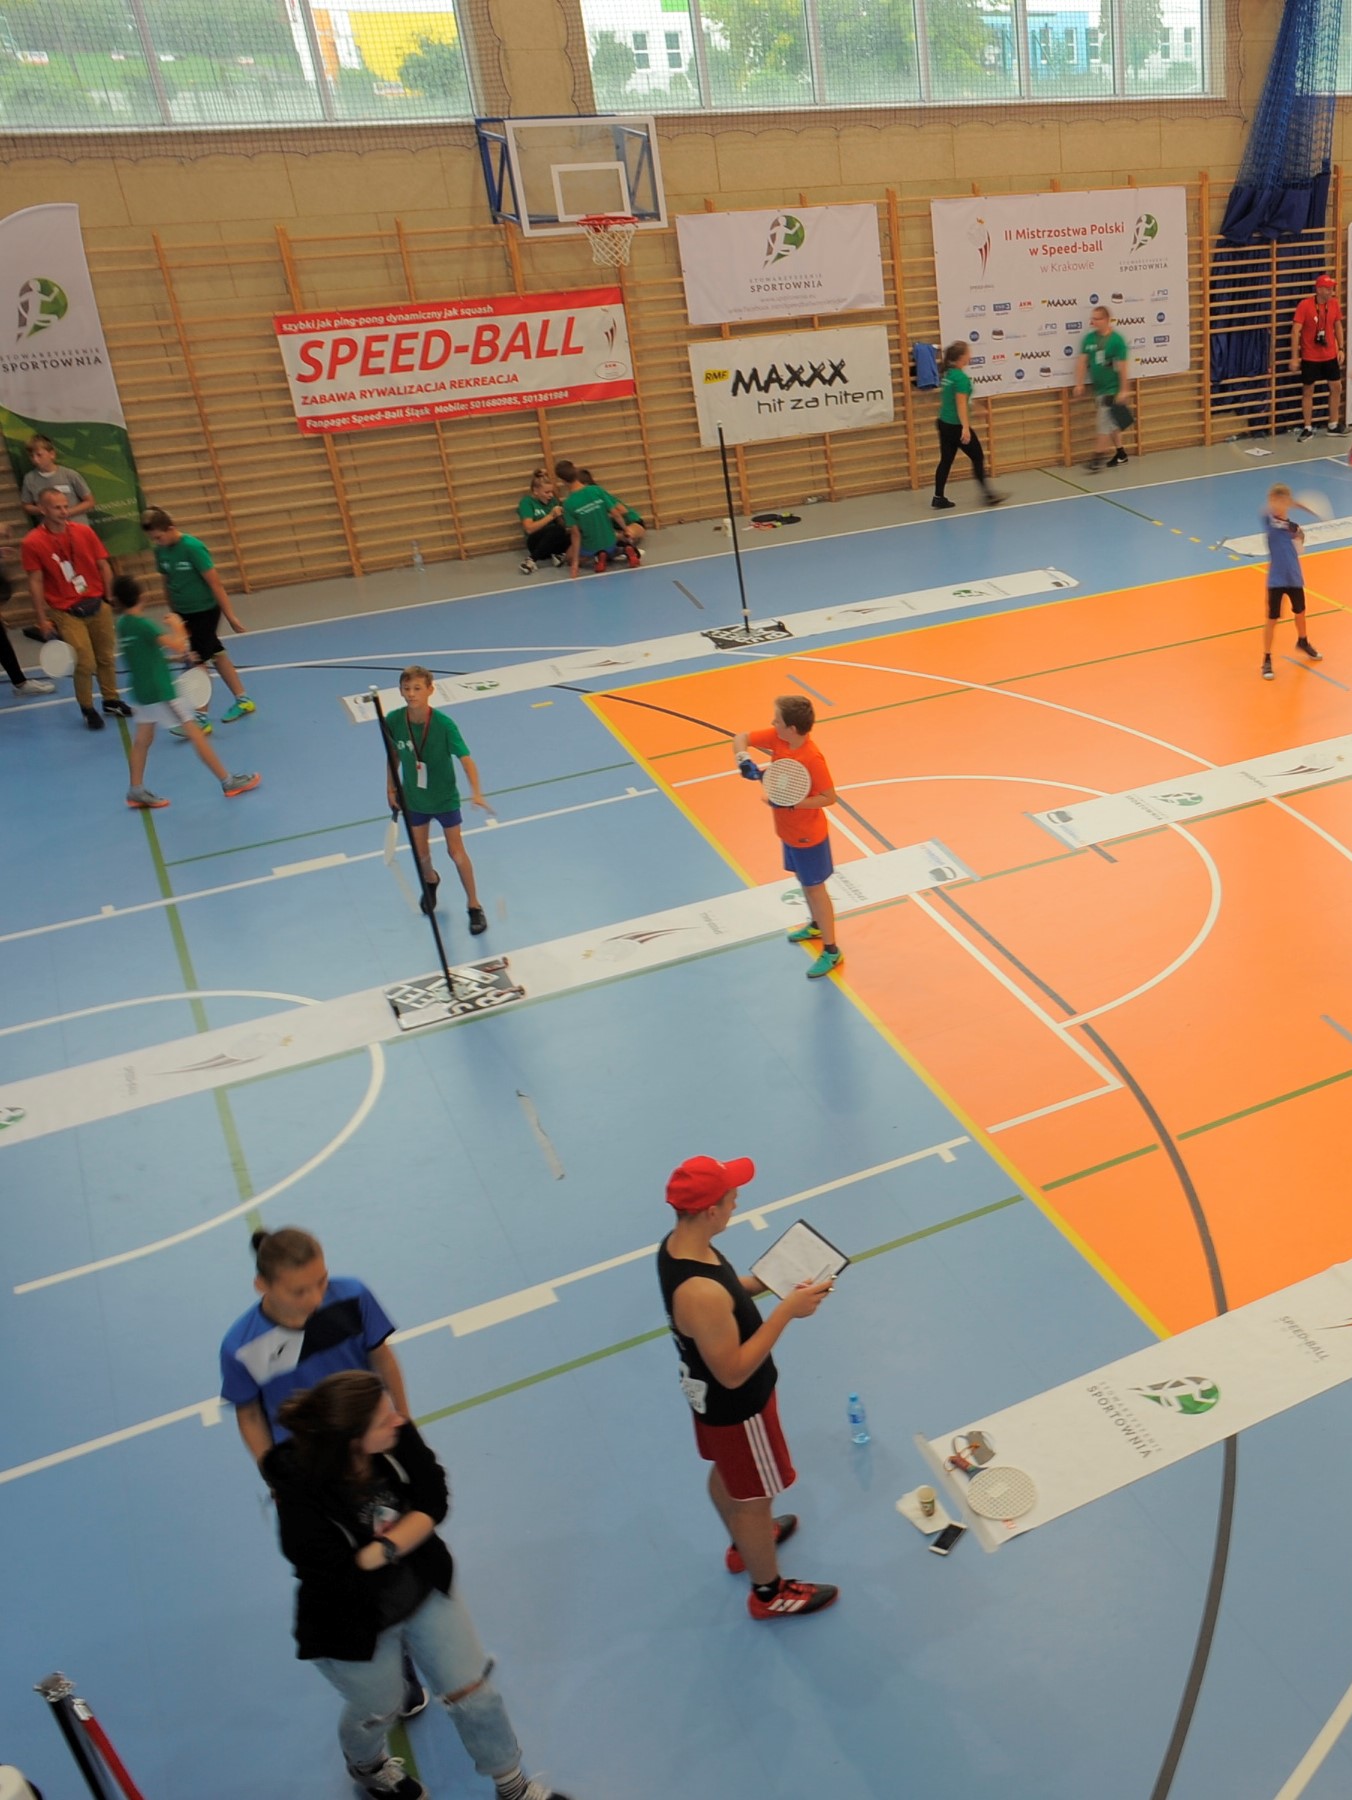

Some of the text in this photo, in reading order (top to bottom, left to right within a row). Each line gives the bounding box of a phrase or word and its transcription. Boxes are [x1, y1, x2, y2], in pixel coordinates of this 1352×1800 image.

[1004, 221, 1125, 241] II Mistrzostwa Polski
[1029, 240, 1103, 257] w Speed-ball
[1051, 260, 1095, 273] Krakowie
[1119, 263, 1168, 273] SPORTOWNIA
[750, 280, 823, 293] SPORTOWNIA
[333, 313, 384, 329] ping-pong
[386, 308, 442, 324] dynamiczny
[460, 304, 493, 318] squash
[296, 316, 584, 384] SPEED-BALL
[2, 356, 102, 373] SPORTOWNIA
[705, 358, 849, 397] RMF MAXXX
[301, 374, 519, 406] ZABAWA RYWALIZACJA REKREACJA
[757, 389, 884, 414] hit za hitem
[1086, 1386, 1152, 1458] SPORTOWNIA
